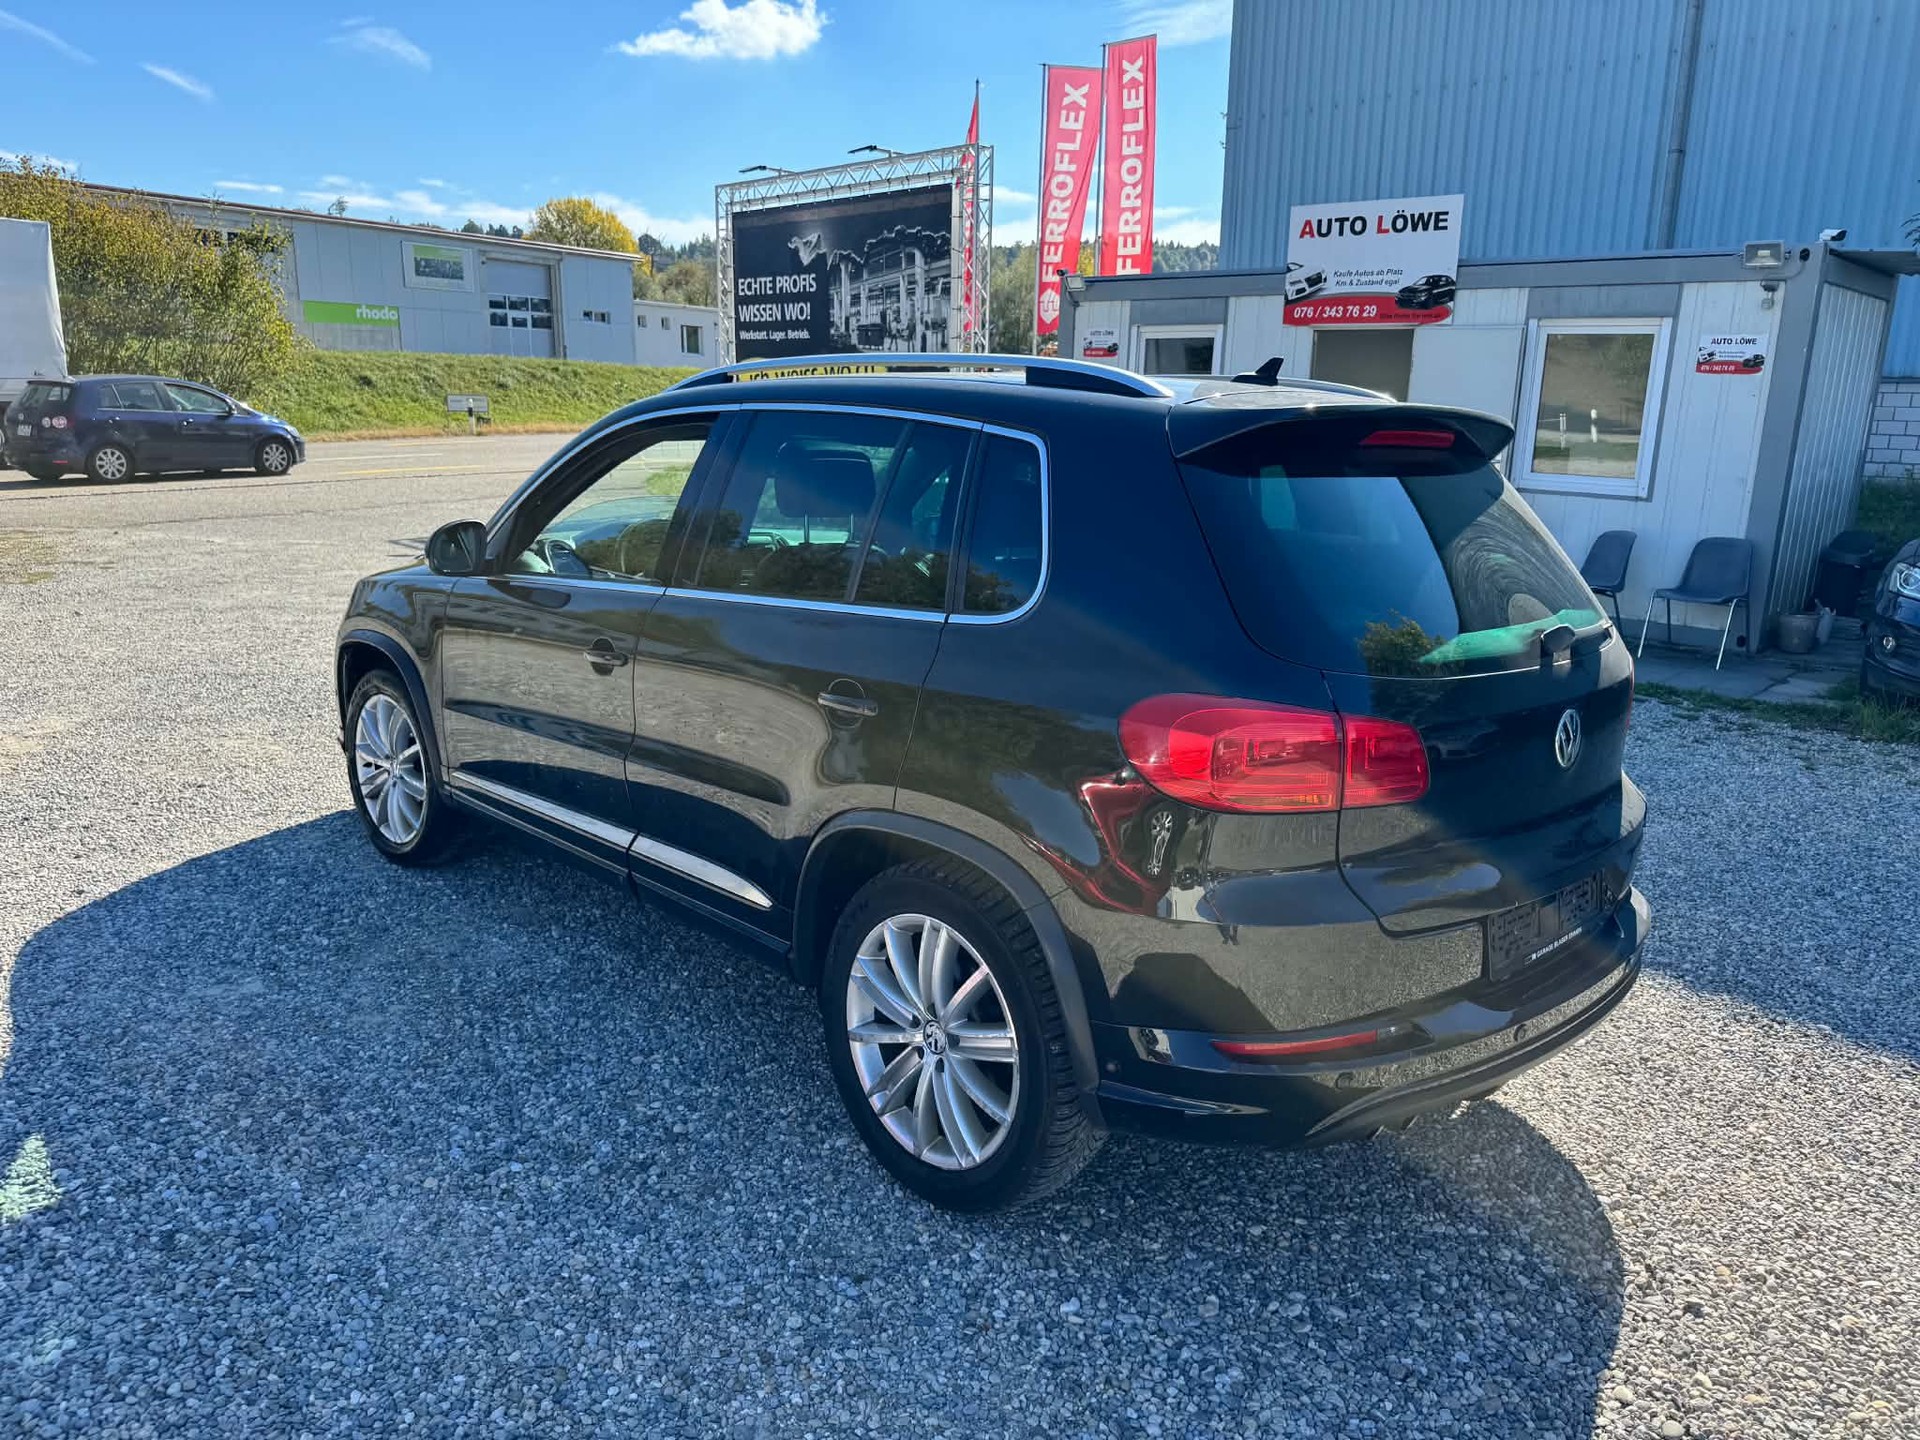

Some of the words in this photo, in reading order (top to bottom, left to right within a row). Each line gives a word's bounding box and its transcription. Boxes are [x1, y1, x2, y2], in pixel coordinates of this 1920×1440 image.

[1116, 55, 1145, 275] FERROFLEX
[1042, 82, 1090, 283] FERROFLEX
[1299, 216, 1368, 239] AUTO
[1376, 210, 1450, 234] LÖWE
[1333, 270, 1353, 278] Kaufe
[738, 277, 773, 296] ECHTE
[776, 273, 817, 294] PROFIS
[1384, 279, 1400, 287] egal
[356, 304, 398, 320] rhodo
[738, 303, 782, 322] WISSEN
[784, 301, 811, 321] WO!
[1294, 307, 1314, 318] 076
[1315, 306, 1321, 318] /
[1323, 306, 1344, 317] 343
[1346, 305, 1360, 317] 76
[1362, 305, 1377, 317] 29
[739, 330, 768, 340] Werkstatt.
[769, 330, 787, 342] Lager.
[788, 328, 811, 339] Betrieb.
[1735, 337, 1758, 345] LÖWE
